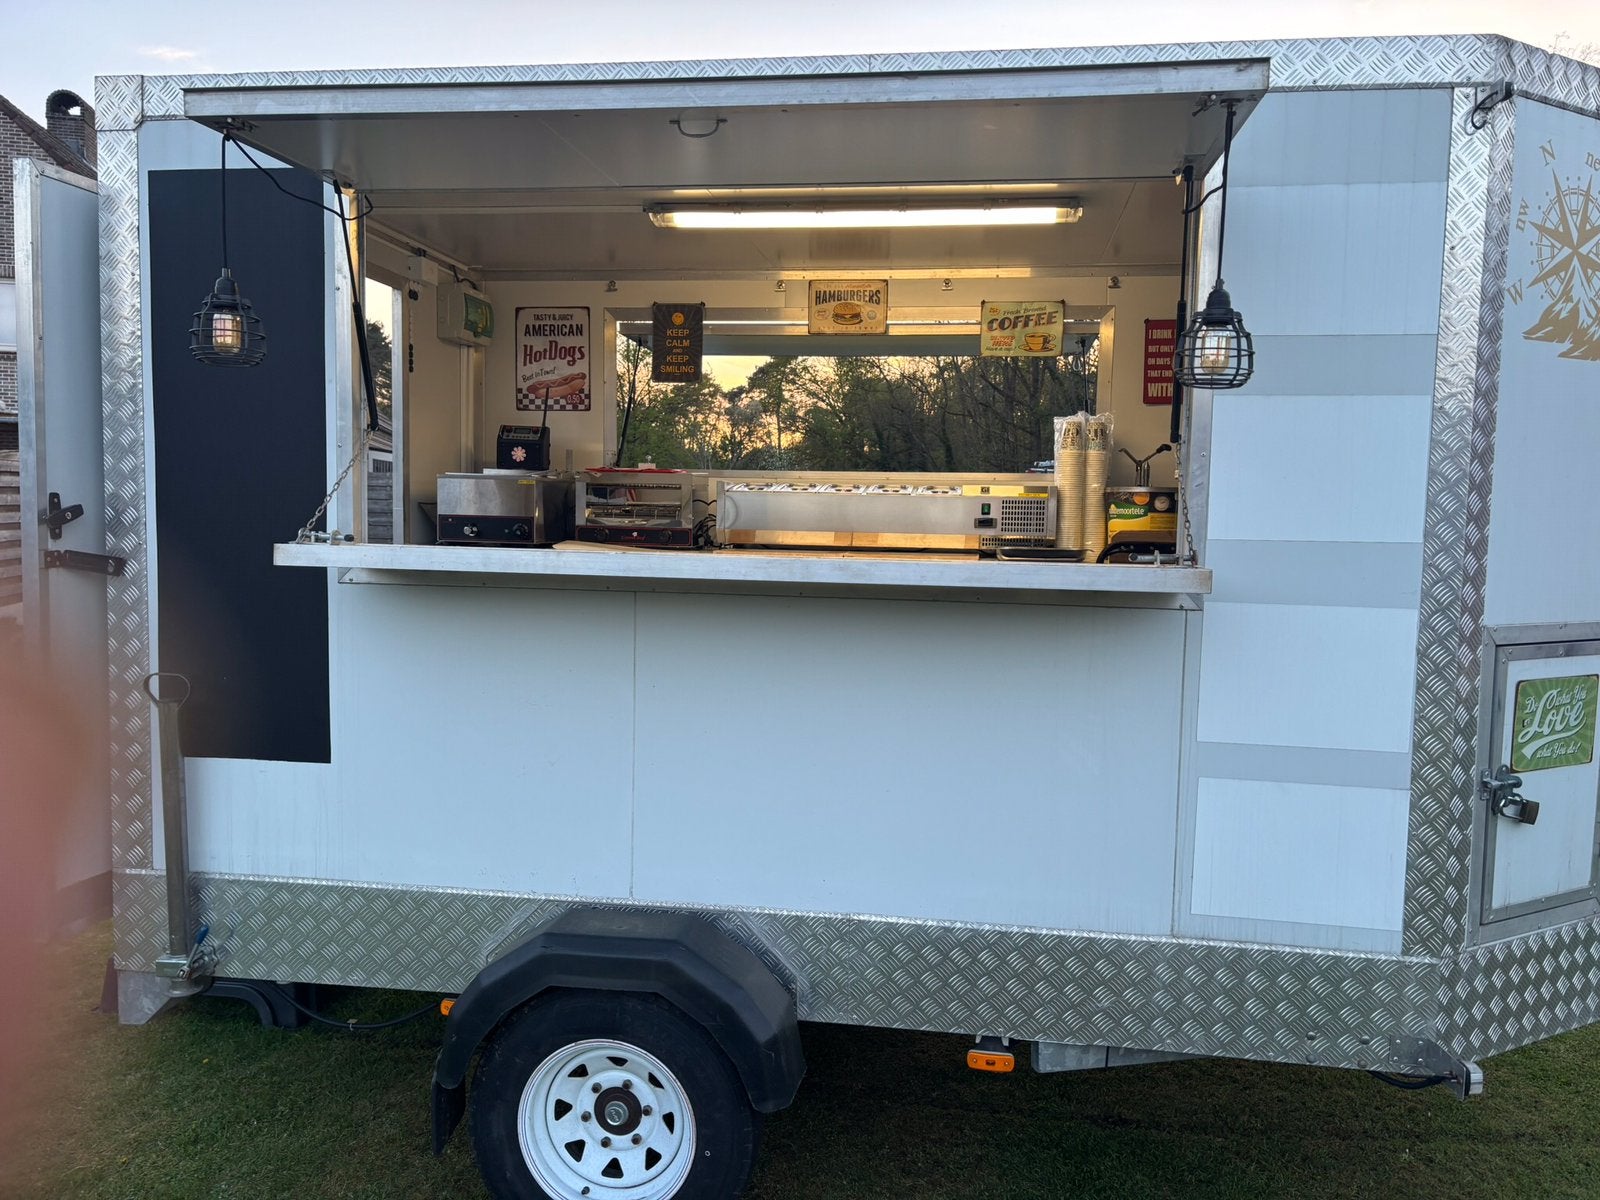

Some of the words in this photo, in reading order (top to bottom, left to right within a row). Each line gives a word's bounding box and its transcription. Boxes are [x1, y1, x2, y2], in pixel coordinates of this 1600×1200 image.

[1539, 139, 1556, 167] N
[815, 289, 881, 306] HAMBURGERS
[1506, 278, 1525, 306] W
[987, 310, 1059, 332] COFFEE
[524, 323, 583, 336] AMERICAN
[666, 328, 690, 336] KEEP
[1148, 329, 1152, 339] I
[1152, 329, 1172, 339] DRINK
[666, 339, 690, 347] CALM
[1148, 345, 1159, 353] BUT
[1160, 345, 1174, 353] ONLY
[660, 365, 695, 373] SMILING
[1147, 383, 1173, 397] WITH
[1518, 688, 1585, 743] Love
